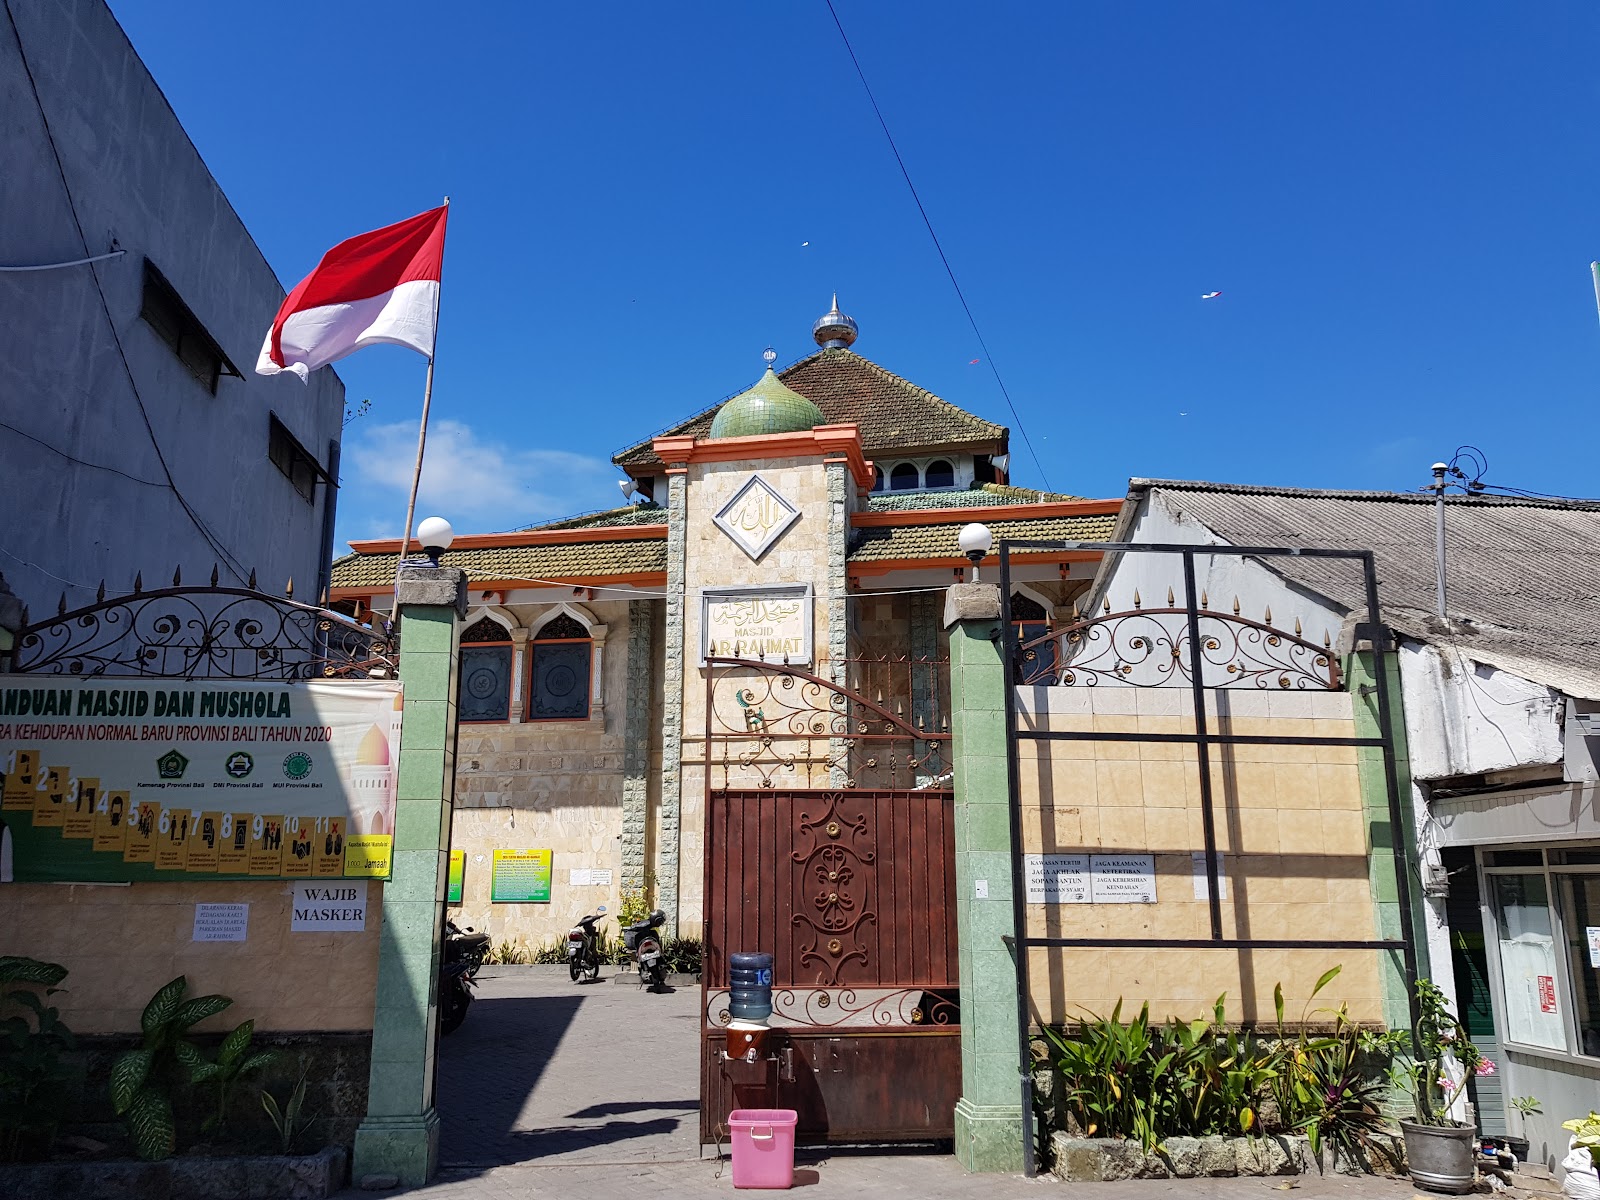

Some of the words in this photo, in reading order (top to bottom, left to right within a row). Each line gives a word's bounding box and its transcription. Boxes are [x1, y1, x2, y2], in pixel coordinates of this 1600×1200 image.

[734, 626, 774, 637] MASJID
[708, 637, 802, 655] AR-RAHMAT
[77, 689, 149, 717] MASJID
[154, 690, 195, 718] DAN
[199, 691, 291, 718] MUSHOLA
[14, 724, 86, 741] KEHIDUPAN
[87, 724, 139, 741] NORMAL
[141, 725, 175, 741] BARU
[176, 725, 229, 742] PROVINSI
[232, 725, 258, 742] BALI
[260, 726, 301, 742] TAHUN
[304, 726, 332, 742] 2020
[8, 749, 17, 775] 1
[36, 766, 49, 792] 2
[67, 778, 78, 804] 3
[97, 790, 109, 816] 4
[127, 800, 140, 826] 5
[158, 808, 171, 834] 6
[191, 811, 203, 836] 7
[221, 812, 233, 839] 8
[252, 815, 264, 840] 9
[284, 816, 299, 834] 10
[315, 816, 330, 834] 11
[364, 858, 388, 869] Jamaah
[303, 888, 357, 901] WAJIB
[294, 908, 363, 921] MASKER
